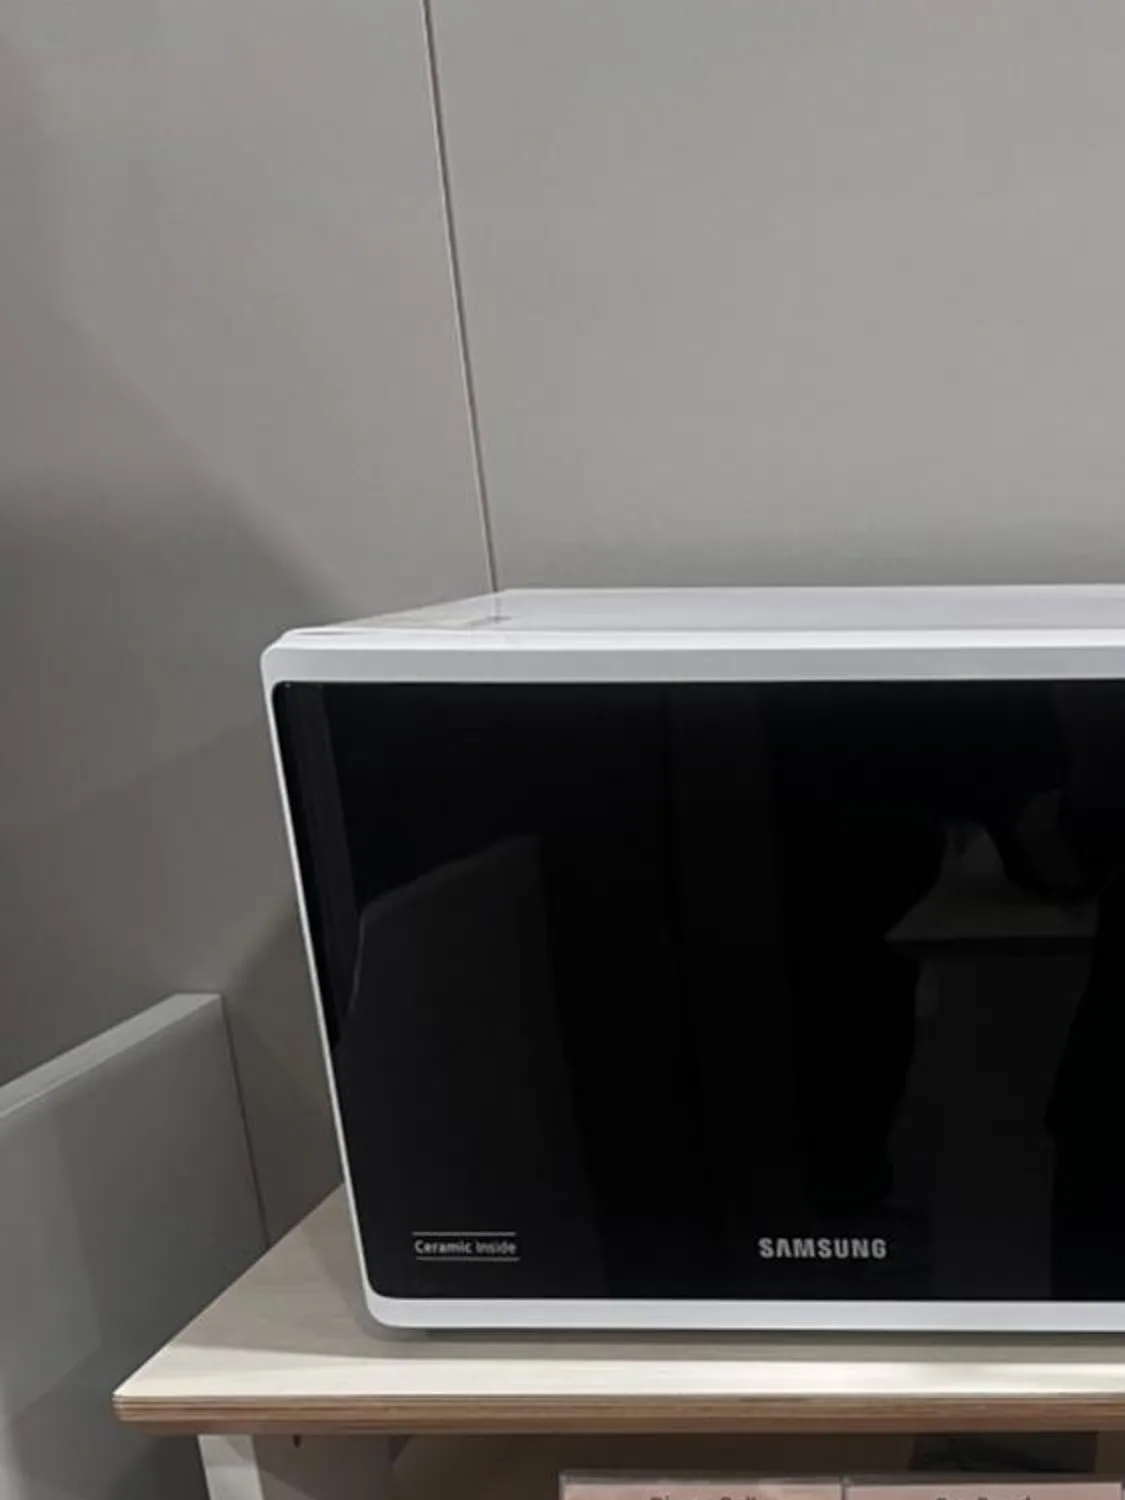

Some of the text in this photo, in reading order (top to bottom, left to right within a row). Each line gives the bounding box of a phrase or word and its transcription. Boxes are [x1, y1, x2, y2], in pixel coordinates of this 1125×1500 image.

[414, 1239, 517, 1255] Ceramic Inside
[758, 1237, 888, 1260] SAMSUNG
